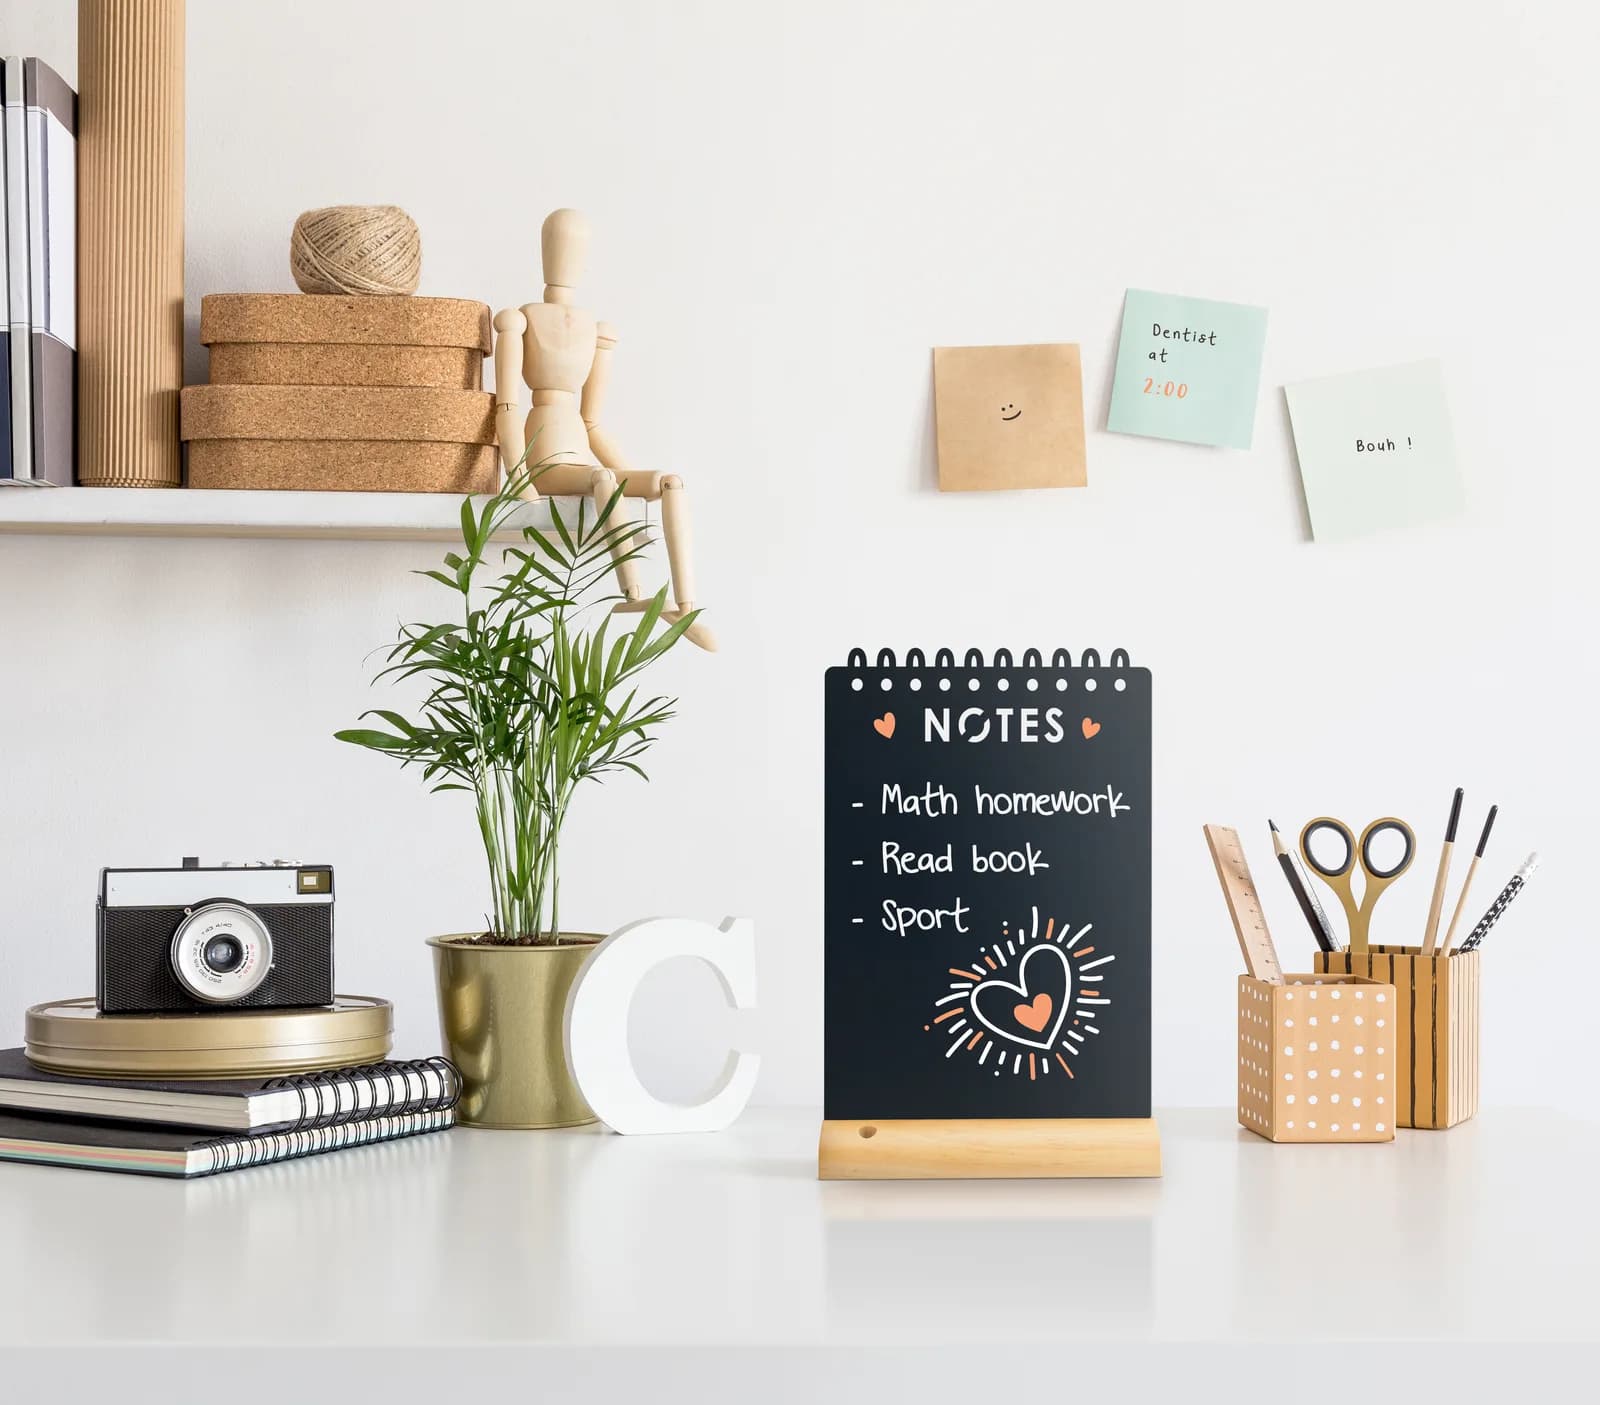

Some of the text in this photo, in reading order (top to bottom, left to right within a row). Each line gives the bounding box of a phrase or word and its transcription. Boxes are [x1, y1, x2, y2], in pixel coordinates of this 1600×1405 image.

[1152, 323, 1217, 346] Dentist
[1148, 347, 1169, 363] at
[1143, 377, 1188, 399] 2:00
[1356, 438, 1396, 452] Bouh
[924, 707, 1065, 744] NOTES
[881, 781, 958, 818] Math
[974, 784, 1131, 818] homework
[882, 840, 953, 875] Read
[972, 841, 1050, 876] book
[881, 896, 970, 937] Sport
[563, 916, 761, 1136] C
